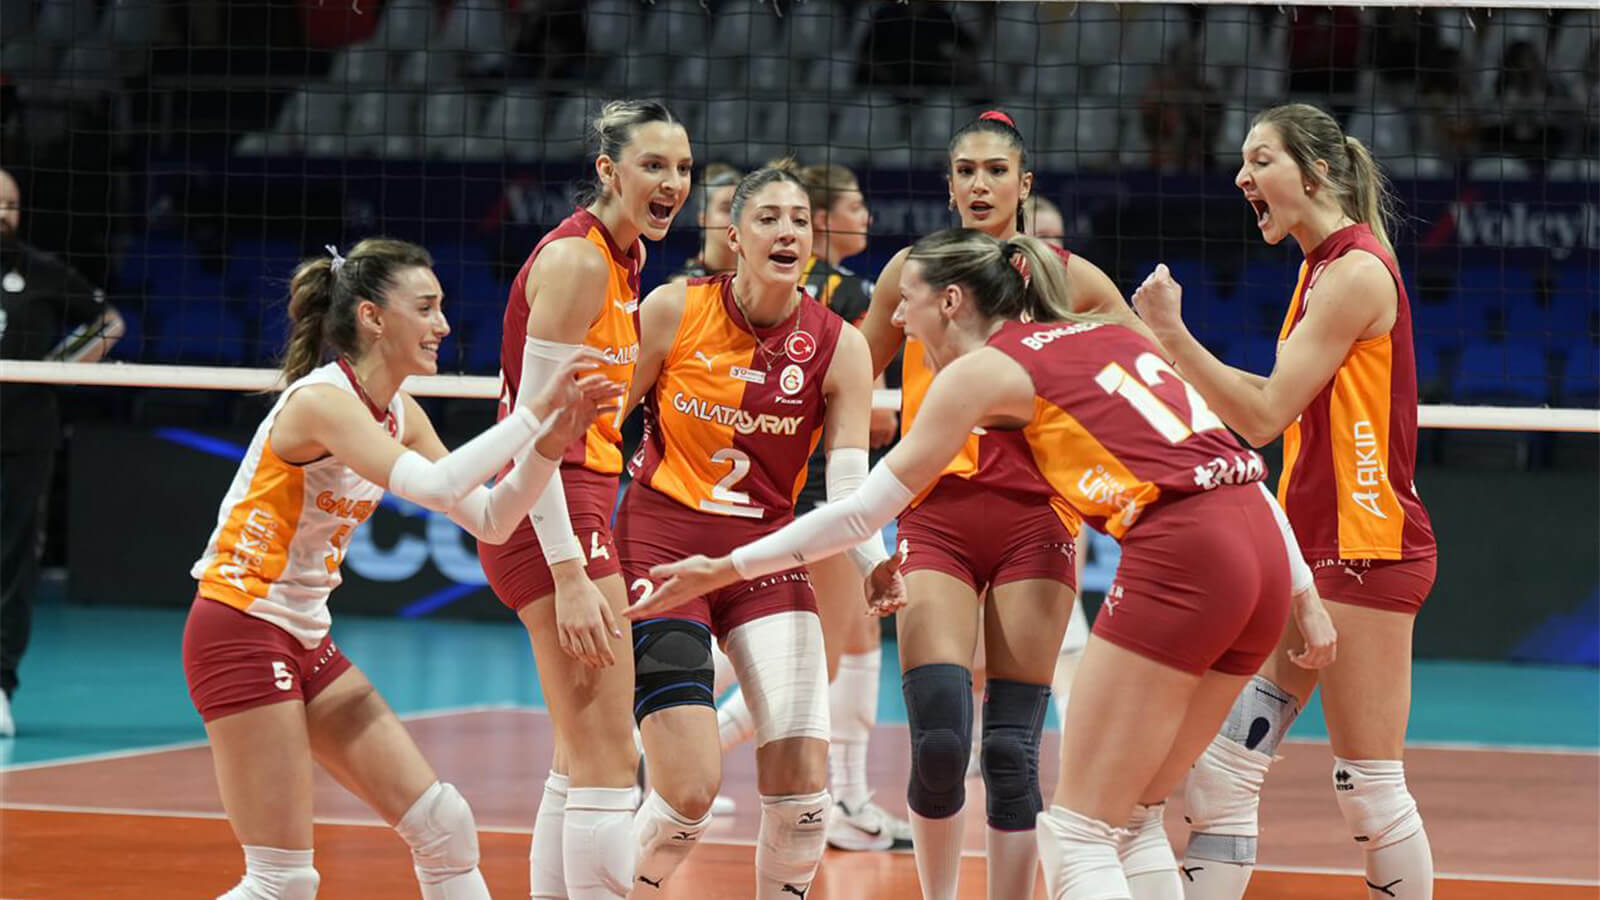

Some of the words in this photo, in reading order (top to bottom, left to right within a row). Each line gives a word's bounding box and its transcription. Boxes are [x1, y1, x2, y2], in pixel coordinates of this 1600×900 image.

[673, 392, 804, 436] GALATASARAY
[1094, 351, 1226, 444] 12
[711, 447, 751, 504] 2
[272, 661, 294, 692] 5
